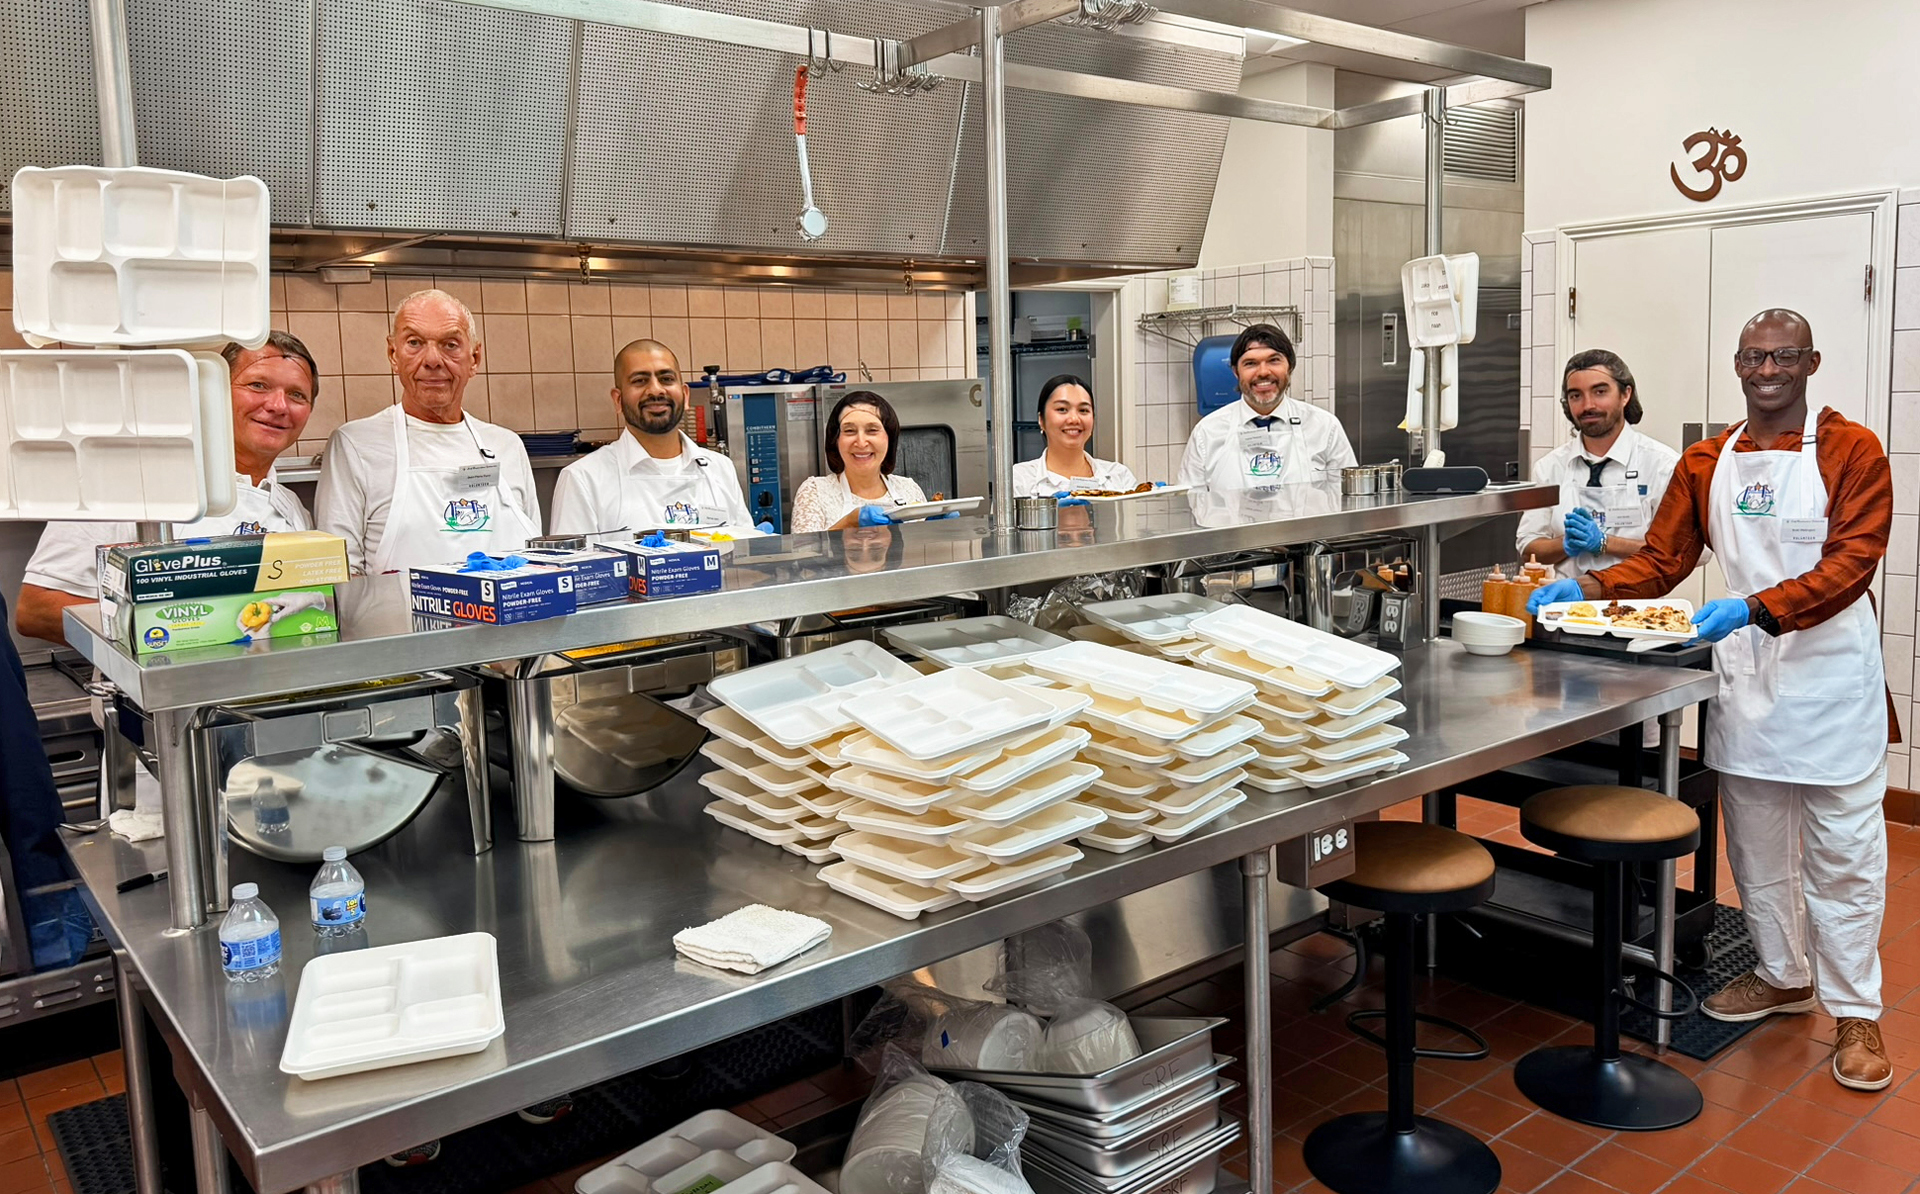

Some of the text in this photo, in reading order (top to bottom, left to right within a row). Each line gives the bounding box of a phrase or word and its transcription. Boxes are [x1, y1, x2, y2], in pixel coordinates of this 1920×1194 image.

[617, 562, 623, 573] L
[706, 556, 716, 567] M
[174, 571, 218, 581] INDUSTRIAL
[219, 568, 248, 577] GLOVES
[267, 559, 283, 580] S
[651, 567, 668, 575] Nitrile
[668, 566, 682, 574] Exam
[561, 577, 569, 589] S
[651, 572, 689, 581] POWDER-FREE
[484, 582, 491, 597] S
[629, 575, 647, 595] OVES
[502, 588, 554, 600] Nitrile Exam Gloves
[411, 594, 452, 616] NITRILE
[453, 601, 497, 623] GLOVES
[502, 596, 542, 608] POWDER-FREE
[161, 605, 208, 619] VINYL
[1141, 1057, 1181, 1094] SRF
[1147, 1124, 1184, 1159] SRF
